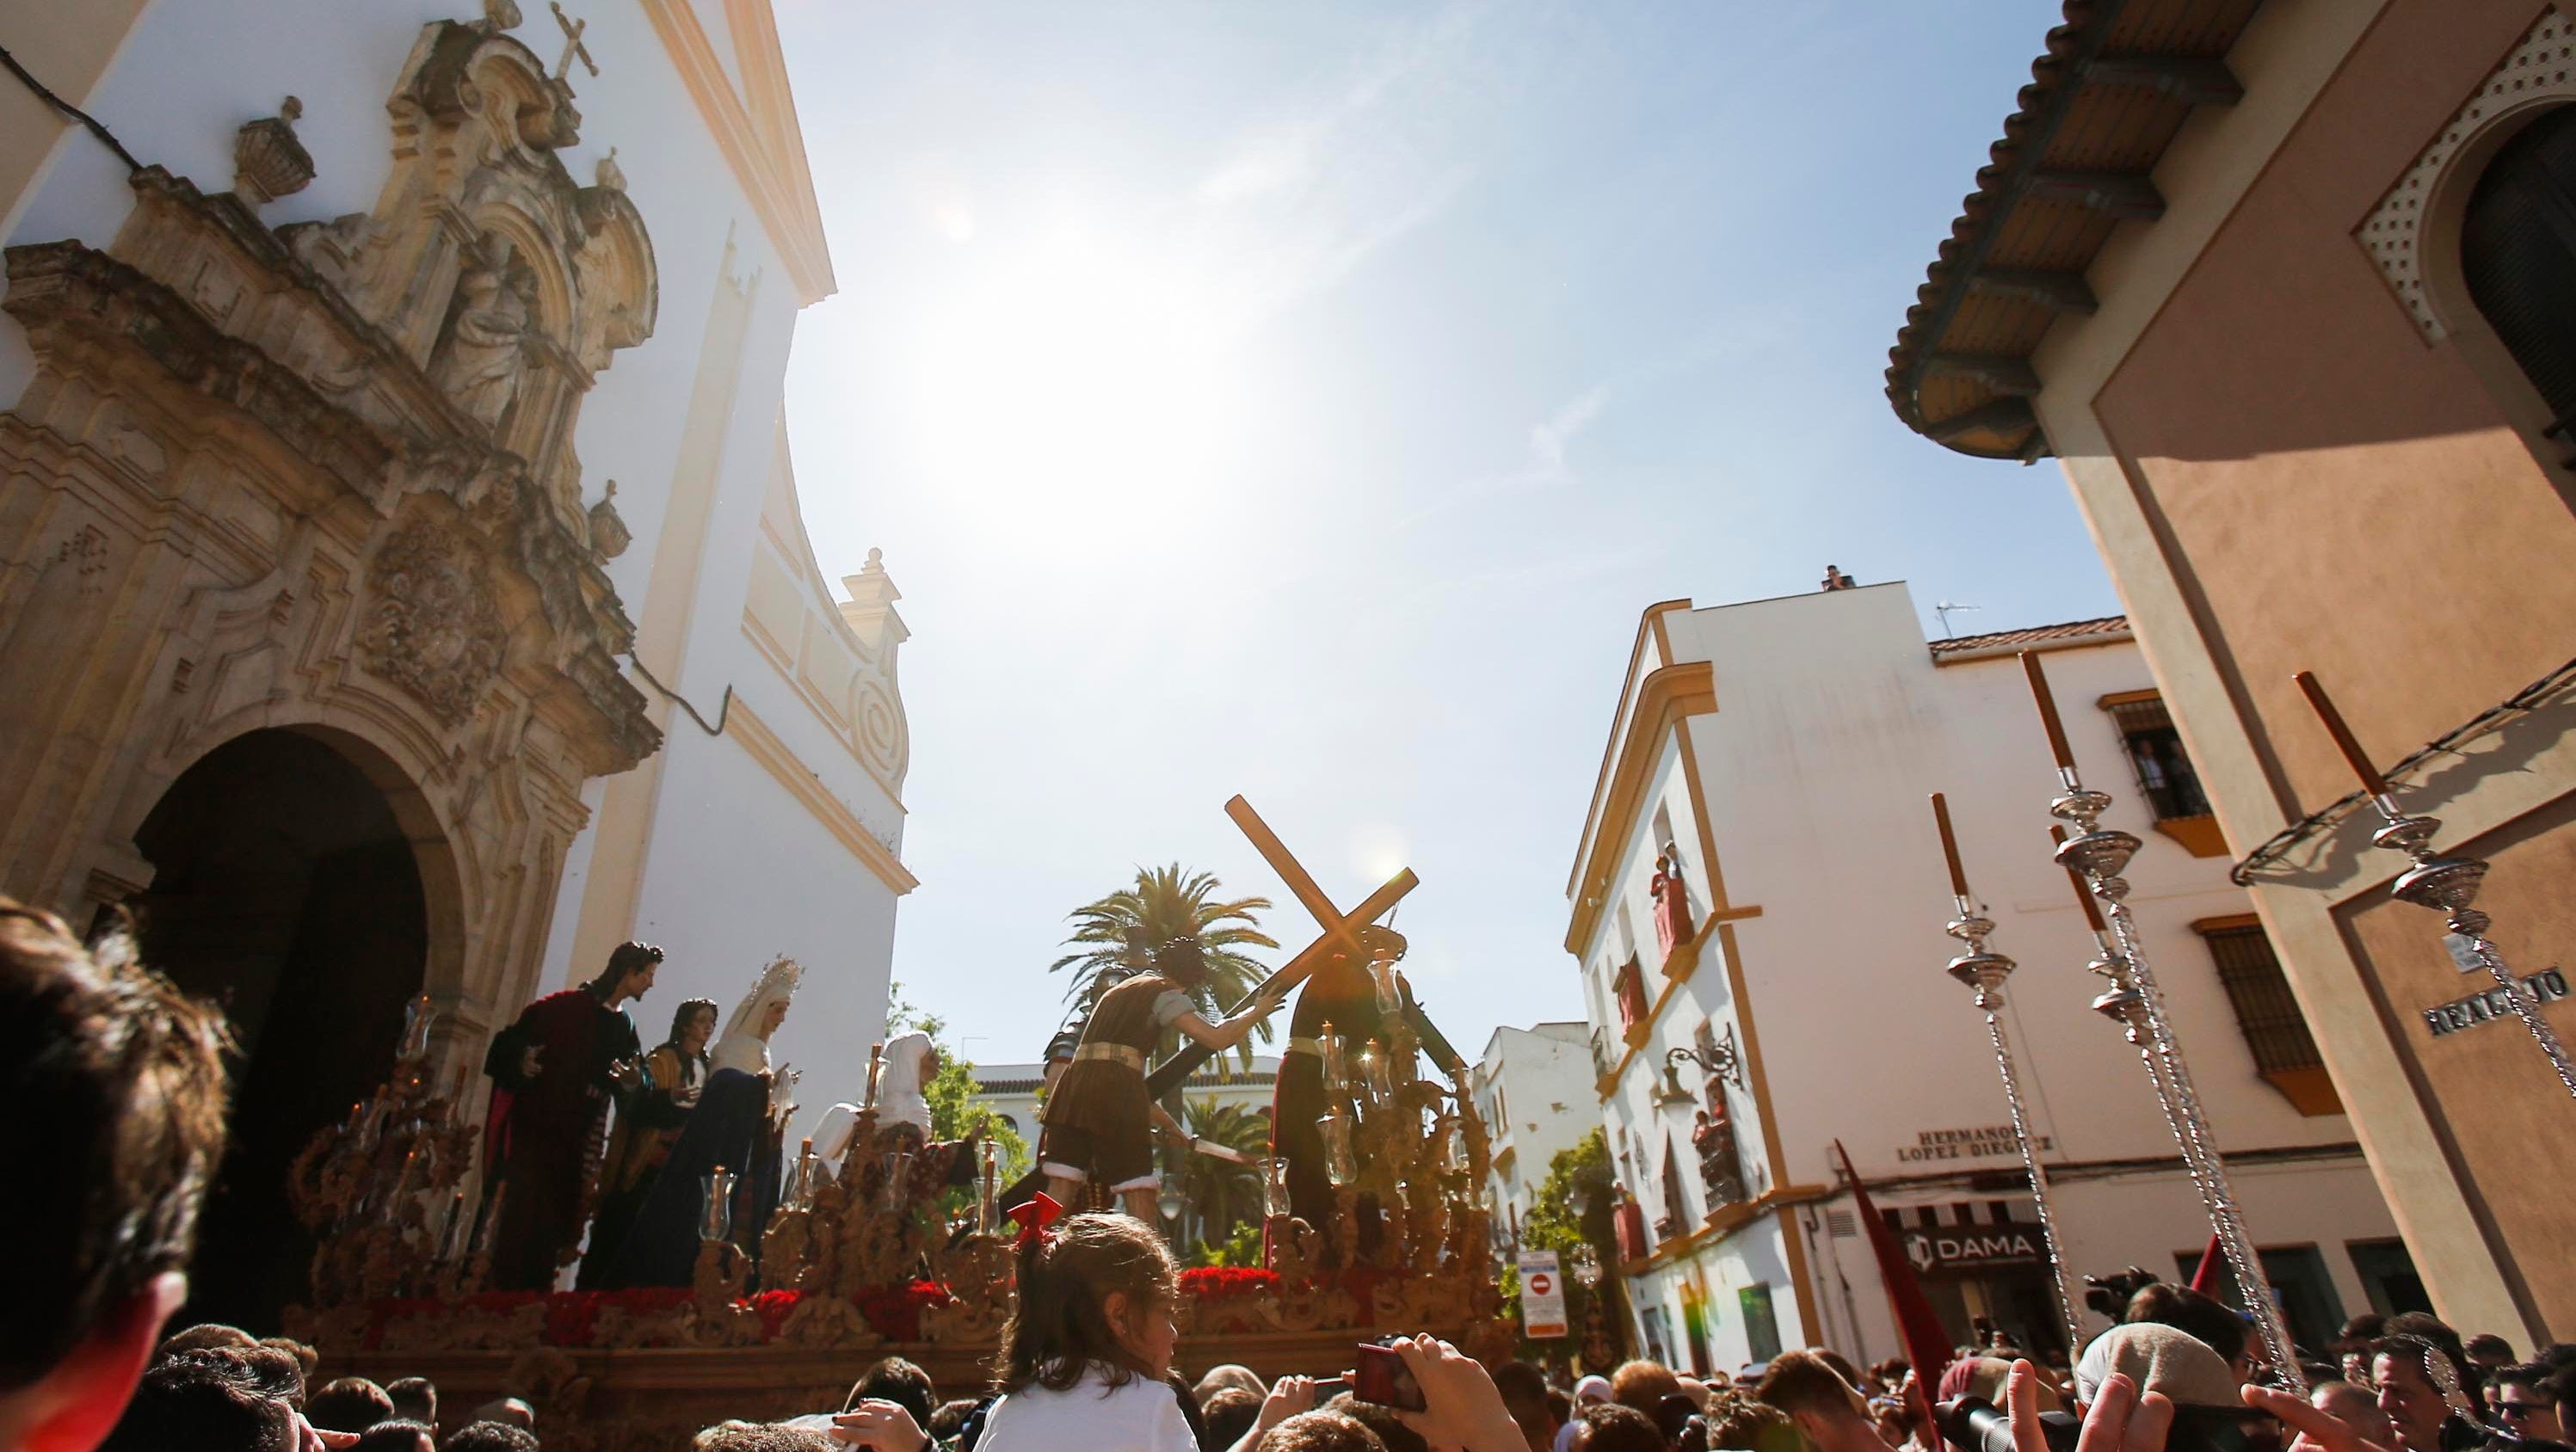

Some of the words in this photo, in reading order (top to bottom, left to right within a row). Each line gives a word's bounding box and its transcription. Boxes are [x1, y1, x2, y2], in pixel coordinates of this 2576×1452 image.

[2424, 969, 2568, 1036] REALJO
[1898, 1145, 1959, 1161] LOPEZ
[1937, 1234, 2036, 1259] DAMA
